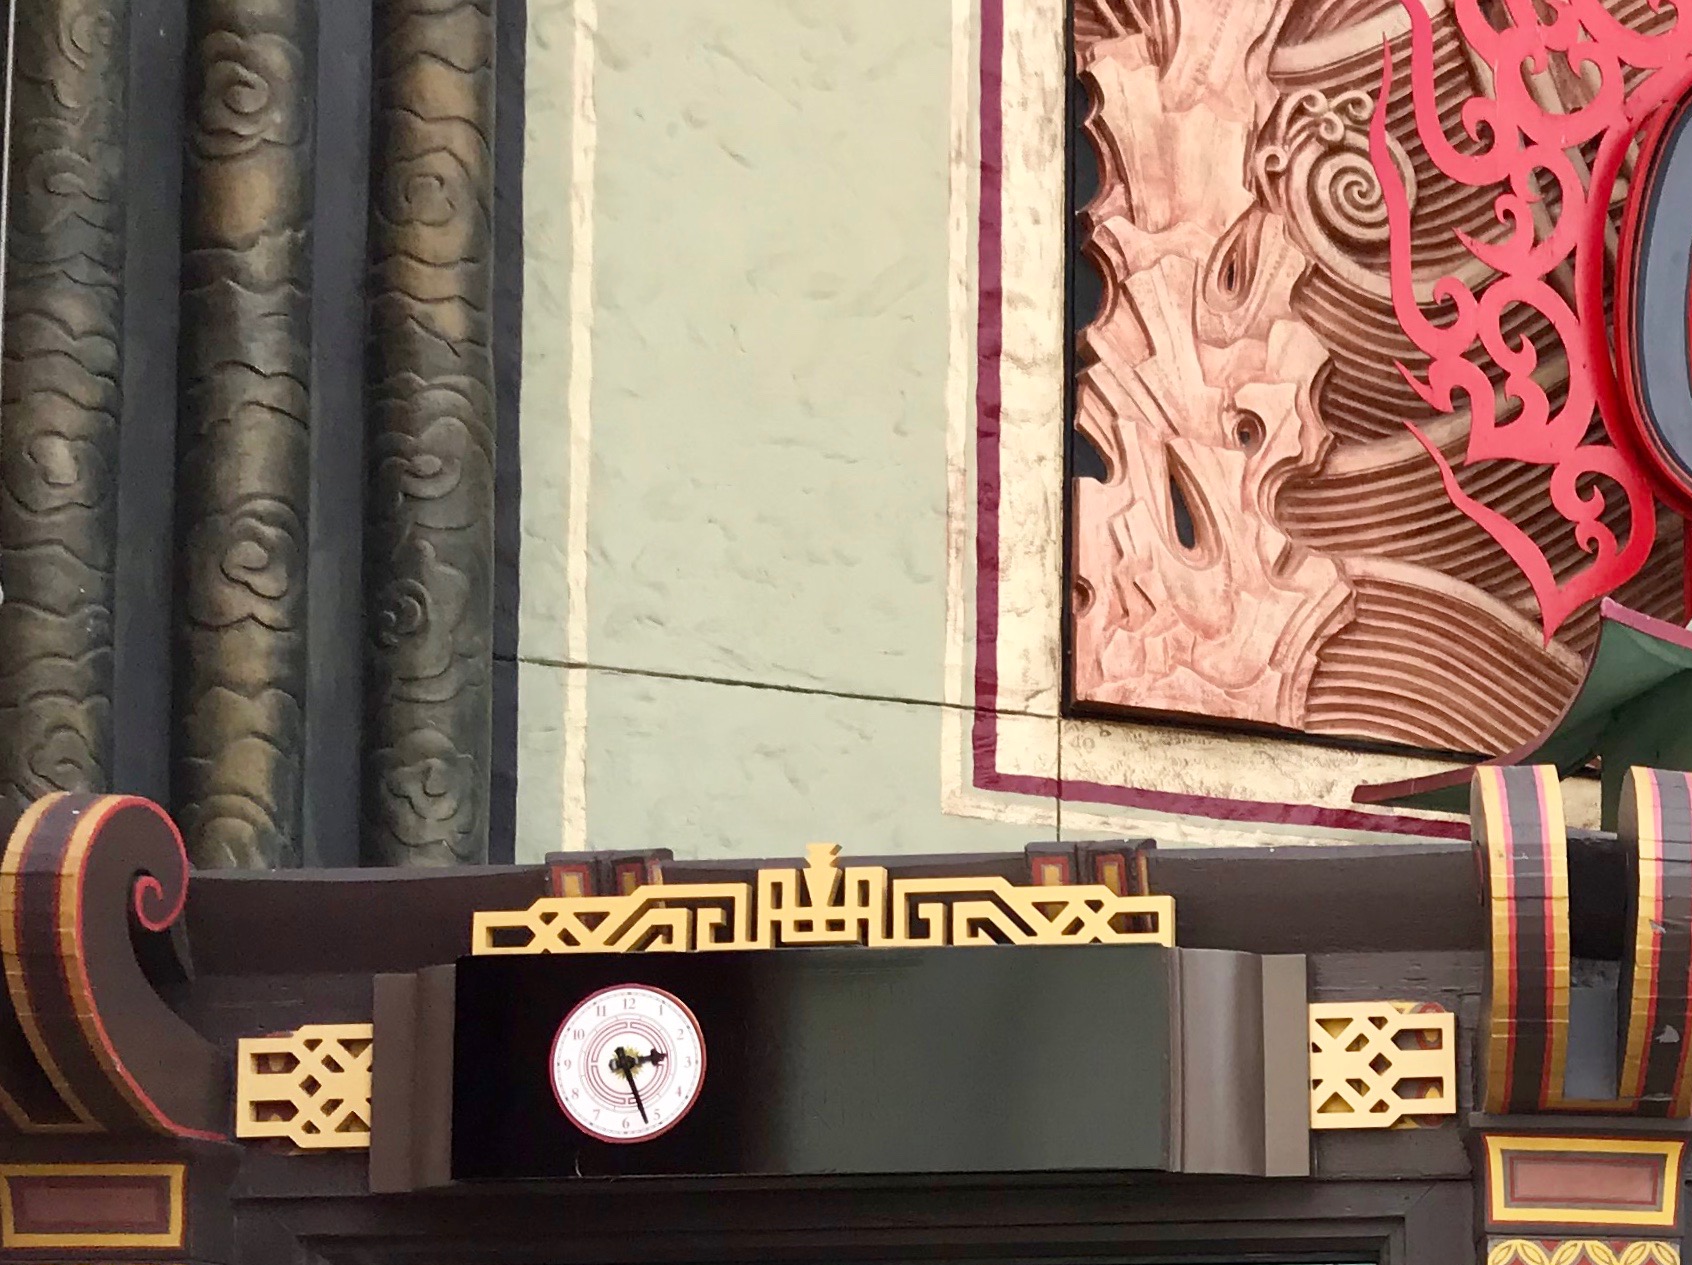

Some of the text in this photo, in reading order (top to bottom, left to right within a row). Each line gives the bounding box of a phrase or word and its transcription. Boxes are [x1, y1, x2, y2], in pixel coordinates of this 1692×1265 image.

[623, 998, 636, 1010] 12
[596, 1005, 607, 1017] 11
[573, 1029, 585, 1040] 10
[677, 1029, 684, 1040] 2
[564, 1058, 572, 1070] 9
[684, 1057, 691, 1068] 3
[572, 1088, 579, 1100] 8
[675, 1086, 682, 1097] 4
[593, 1109, 601, 1120] 7
[654, 1109, 661, 1120] 5
[622, 1118, 630, 1128] 6
